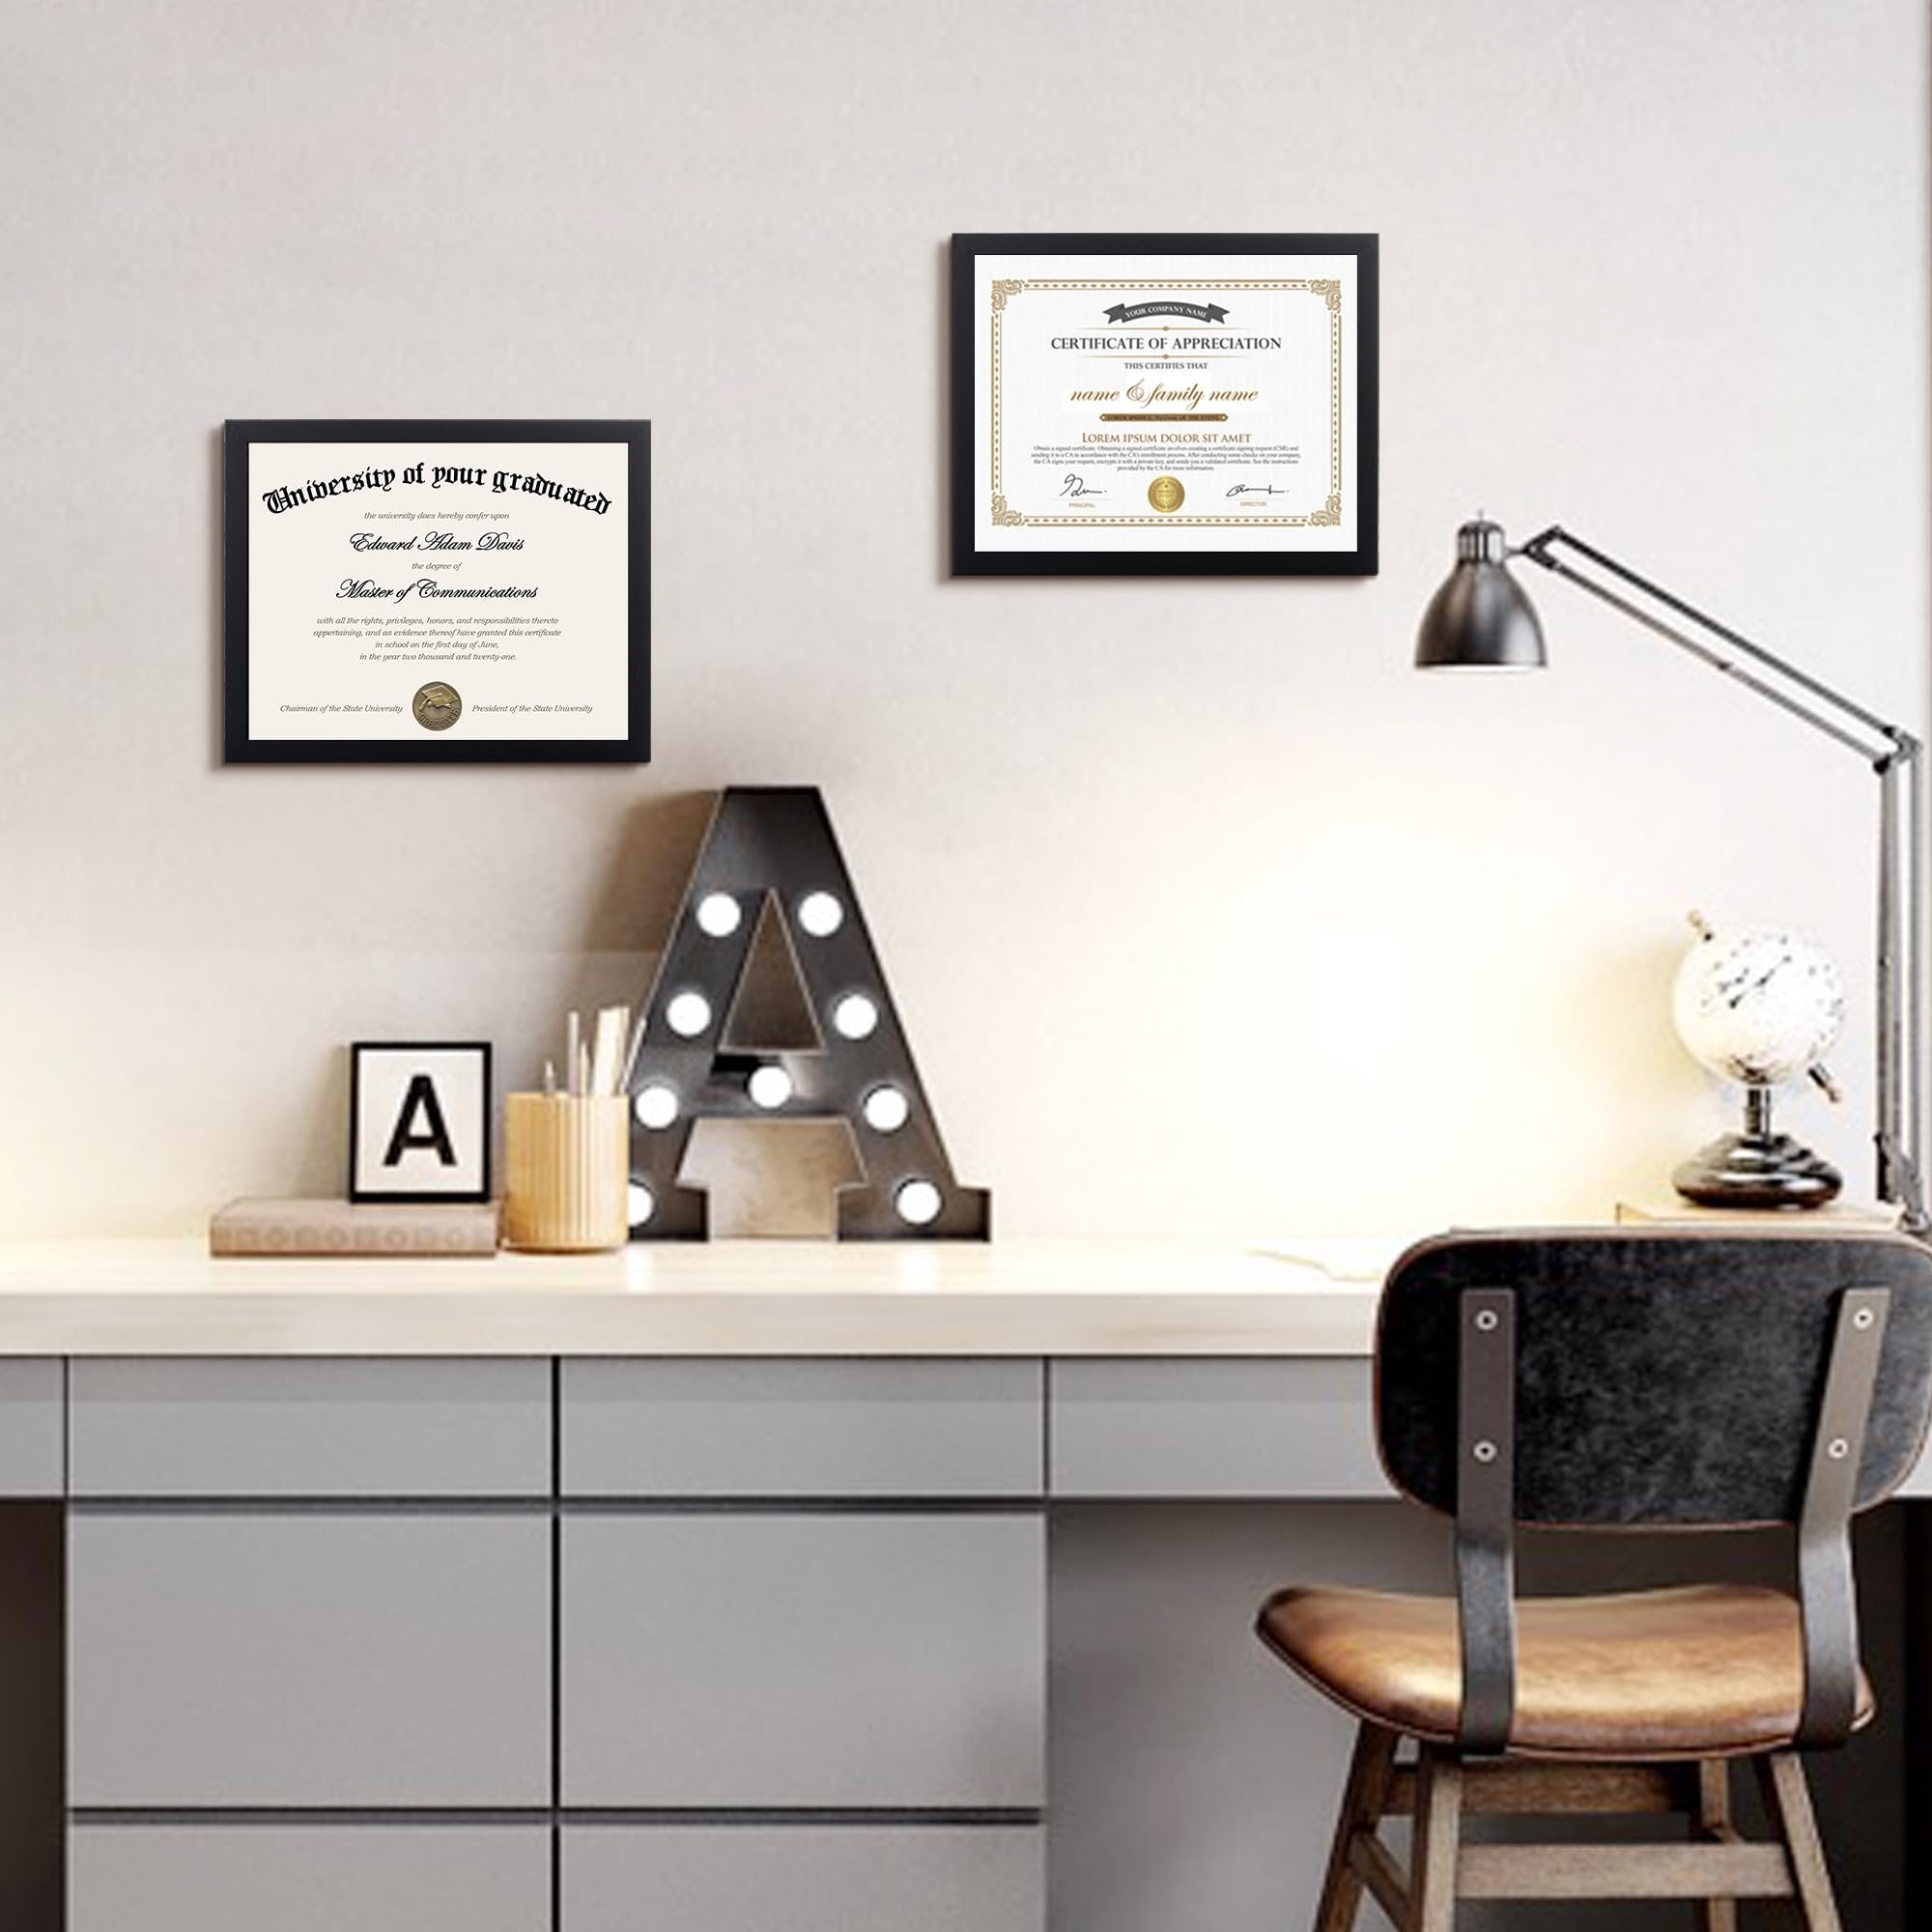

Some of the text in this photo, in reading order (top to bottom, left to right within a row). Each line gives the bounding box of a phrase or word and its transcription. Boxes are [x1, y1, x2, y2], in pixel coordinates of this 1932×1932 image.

[1051, 338, 1281, 350] CERTIFICATE OF APPRECIATION
[1070, 379, 1258, 411] name & family name
[1082, 433, 1252, 443] LOREM IPSUM DOLOR SIT AMET
[263, 462, 612, 515] University of your graduated
[378, 510, 415, 521] university
[438, 511, 464, 521] hereby
[466, 511, 490, 521] confer
[491, 511, 509, 521] upon
[350, 531, 525, 552] Edward Adam Davis
[426, 562, 452, 571] degree
[453, 562, 463, 571] of
[336, 579, 538, 604] Master of Communications
[361, 616, 384, 626] rights,
[385, 617, 424, 626] privileges,
[426, 617, 454, 626] honors,
[473, 616, 530, 626] responsibilities
[531, 617, 558, 626] thereto
[313, 627, 363, 638] appertaining,
[429, 629, 457, 638] thereof
[476, 627, 508, 638] granted
[524, 629, 561, 638] certificate
[434, 640, 451, 650] first
[452, 641, 469, 650] day
[469, 641, 479, 650] of
[382, 651, 401, 662] year
[402, 651, 417, 660] two
[418, 651, 455, 660] thousand
[473, 653, 516, 662] twenty-one.
[320, 705, 329, 714] of
[365, 703, 403, 714] University
[509, 705, 520, 714] of
[554, 705, 593, 714] University
[383, 1074, 458, 1166] A
